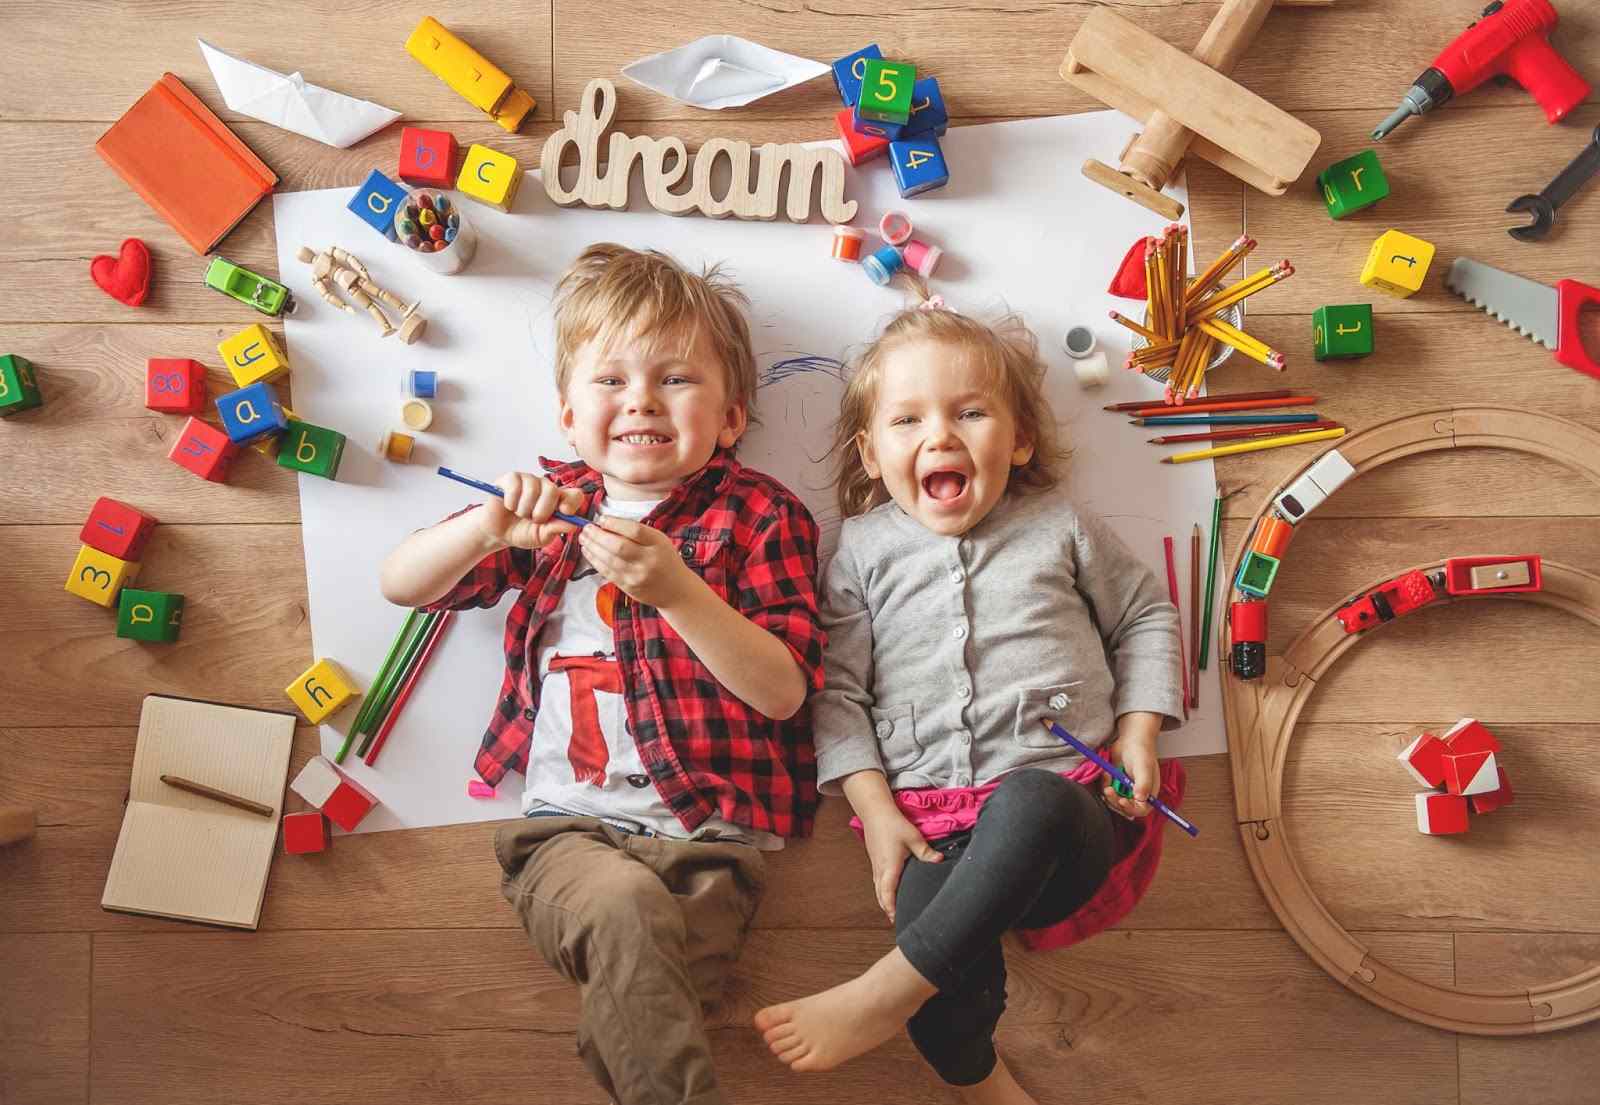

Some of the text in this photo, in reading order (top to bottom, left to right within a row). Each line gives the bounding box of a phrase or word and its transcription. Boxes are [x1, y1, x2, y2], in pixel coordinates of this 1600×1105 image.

[874, 69, 900, 101] 5
[415, 136, 438, 170] b
[541, 78, 858, 223] dream
[906, 150, 935, 169] 4
[477, 161, 496, 183] c
[1351, 167, 1365, 192] r
[367, 191, 393, 214] a
[1391, 255, 1417, 268] t
[1336, 320, 1362, 336] t
[234, 342, 265, 367] y
[153, 374, 184, 394] 8
[235, 400, 261, 424] a
[296, 430, 317, 463] b
[80, 566, 111, 590] 3
[130, 604, 153, 624] a
[304, 677, 333, 708] y
